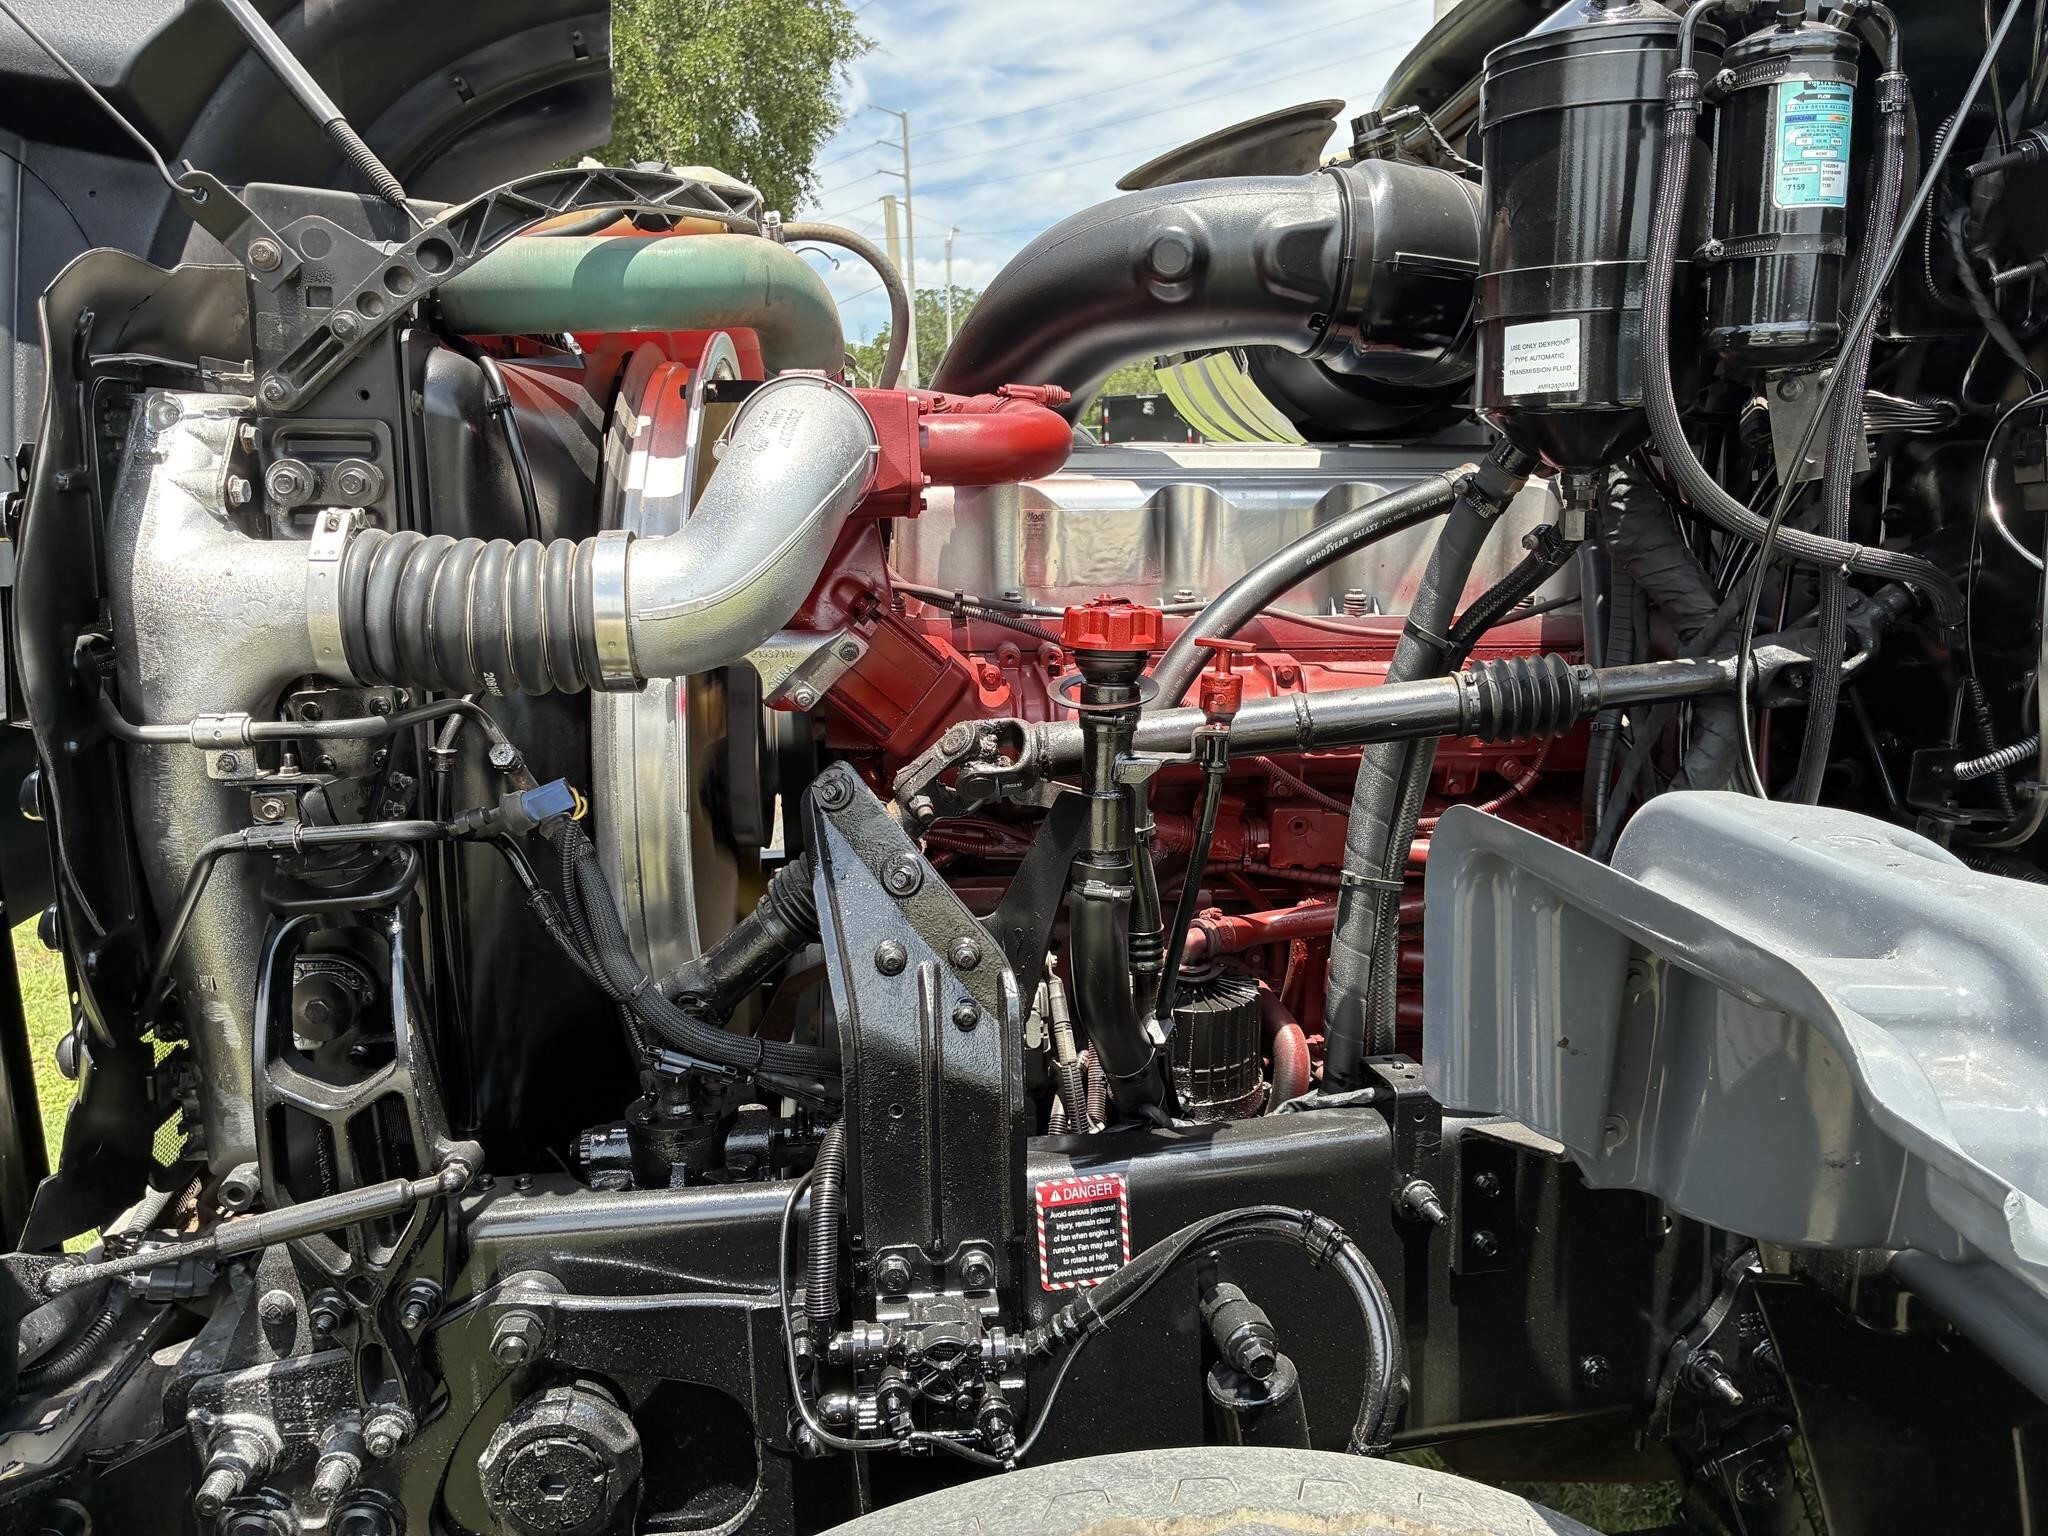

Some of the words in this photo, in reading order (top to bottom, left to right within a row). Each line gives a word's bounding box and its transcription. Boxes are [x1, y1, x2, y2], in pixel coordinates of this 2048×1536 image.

[1522, 342, 1537, 350] ONLY
[1530, 353, 1565, 361] AUTOMATIC
[1509, 366, 1551, 376] TRANSMISSION
[1305, 536, 1349, 566] GOODYEAR
[1353, 521, 1379, 540] GALAXY
[1393, 511, 1408, 521] HOSE
[1063, 1183, 1112, 1200] DANGER
[1050, 1210, 1067, 1219] Avoid
[1068, 1208, 1089, 1217] serious
[1090, 1204, 1115, 1214] personal
[1056, 1222, 1073, 1231] injury,
[1075, 1219, 1095, 1227] remain
[1089, 1229, 1108, 1238] engine
[1053, 1246, 1077, 1254] running.
[1078, 1243, 1089, 1251] Fan
[1091, 1242, 1103, 1250] may
[1071, 1255, 1087, 1263] rotate
[1096, 1252, 1108, 1261] high
[1053, 1270, 1072, 1279] speed
[1073, 1267, 1094, 1275] without
[1095, 1263, 1119, 1273] warning.
